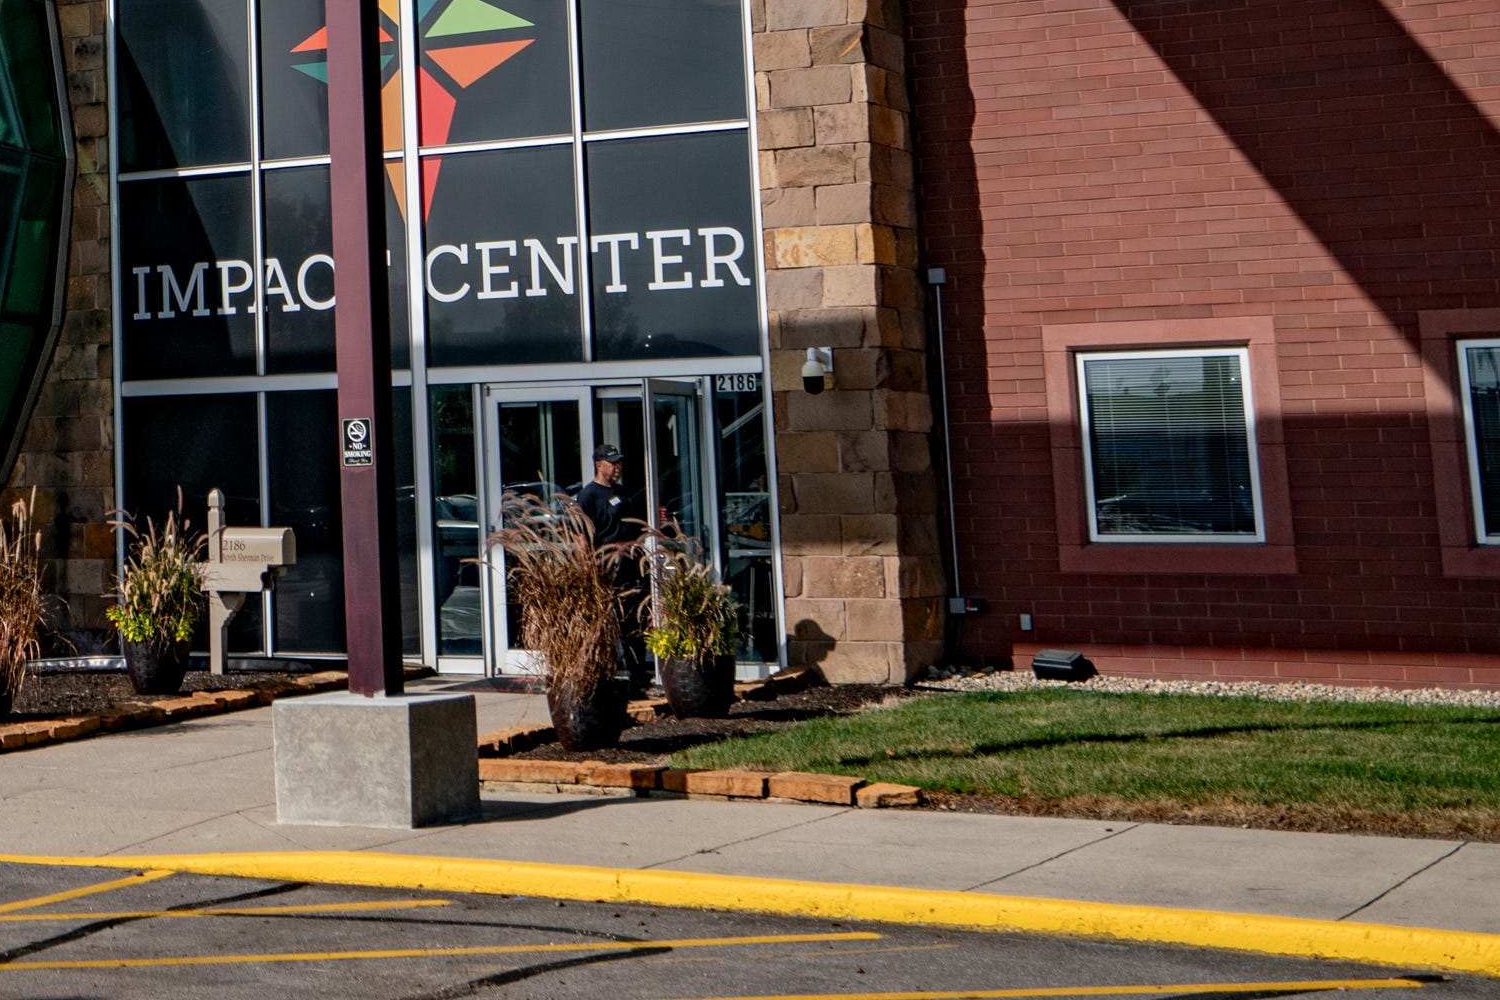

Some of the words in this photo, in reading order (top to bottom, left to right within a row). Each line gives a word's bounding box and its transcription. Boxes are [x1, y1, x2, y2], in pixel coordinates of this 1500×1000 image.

[132, 250, 391, 320] IMPAC
[425, 226, 751, 303] CENTER
[717, 374, 755, 391] 2186
[352, 442, 363, 450] NO
[344, 450, 372, 458] SMOKING
[222, 540, 246, 551] 2186
